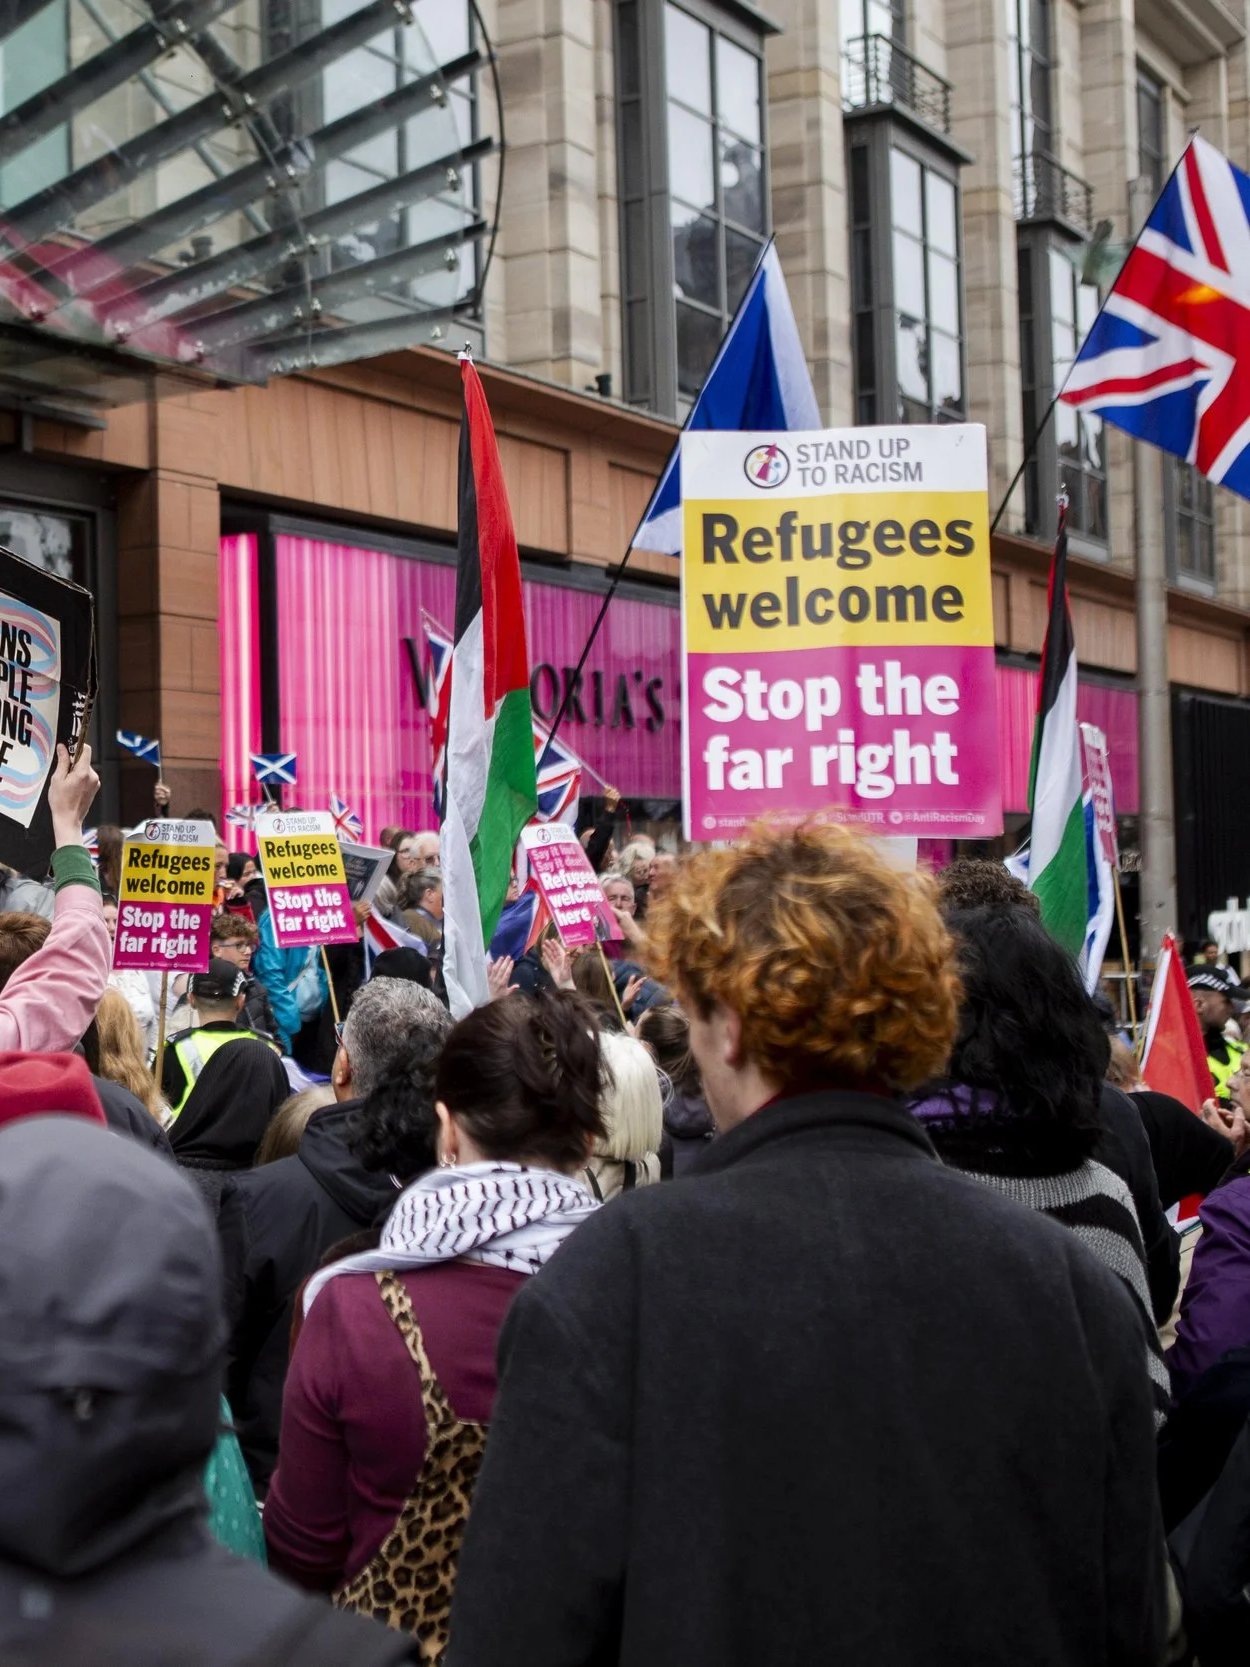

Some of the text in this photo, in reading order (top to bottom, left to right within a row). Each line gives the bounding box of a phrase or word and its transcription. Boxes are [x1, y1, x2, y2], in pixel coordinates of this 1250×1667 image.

[797, 437, 911, 464] STAND UP
[797, 460, 924, 488] TO RACISM
[702, 510, 975, 571] Refugees
[702, 576, 964, 630] welcome
[702, 660, 961, 733] Stop the
[702, 729, 960, 799] far right
[161, 823, 197, 834] STAND UP
[161, 832, 199, 843] TO RACISM
[128, 848, 211, 875] Refugees
[265, 841, 337, 860] Refugees
[269, 862, 338, 879] welcome
[126, 874, 205, 896] welcome
[548, 887, 604, 908] welcome
[273, 888, 341, 912] Stop the
[121, 906, 200, 932] Stop the
[277, 910, 346, 933] far right
[554, 906, 591, 927] here
[119, 931, 197, 959] far right
